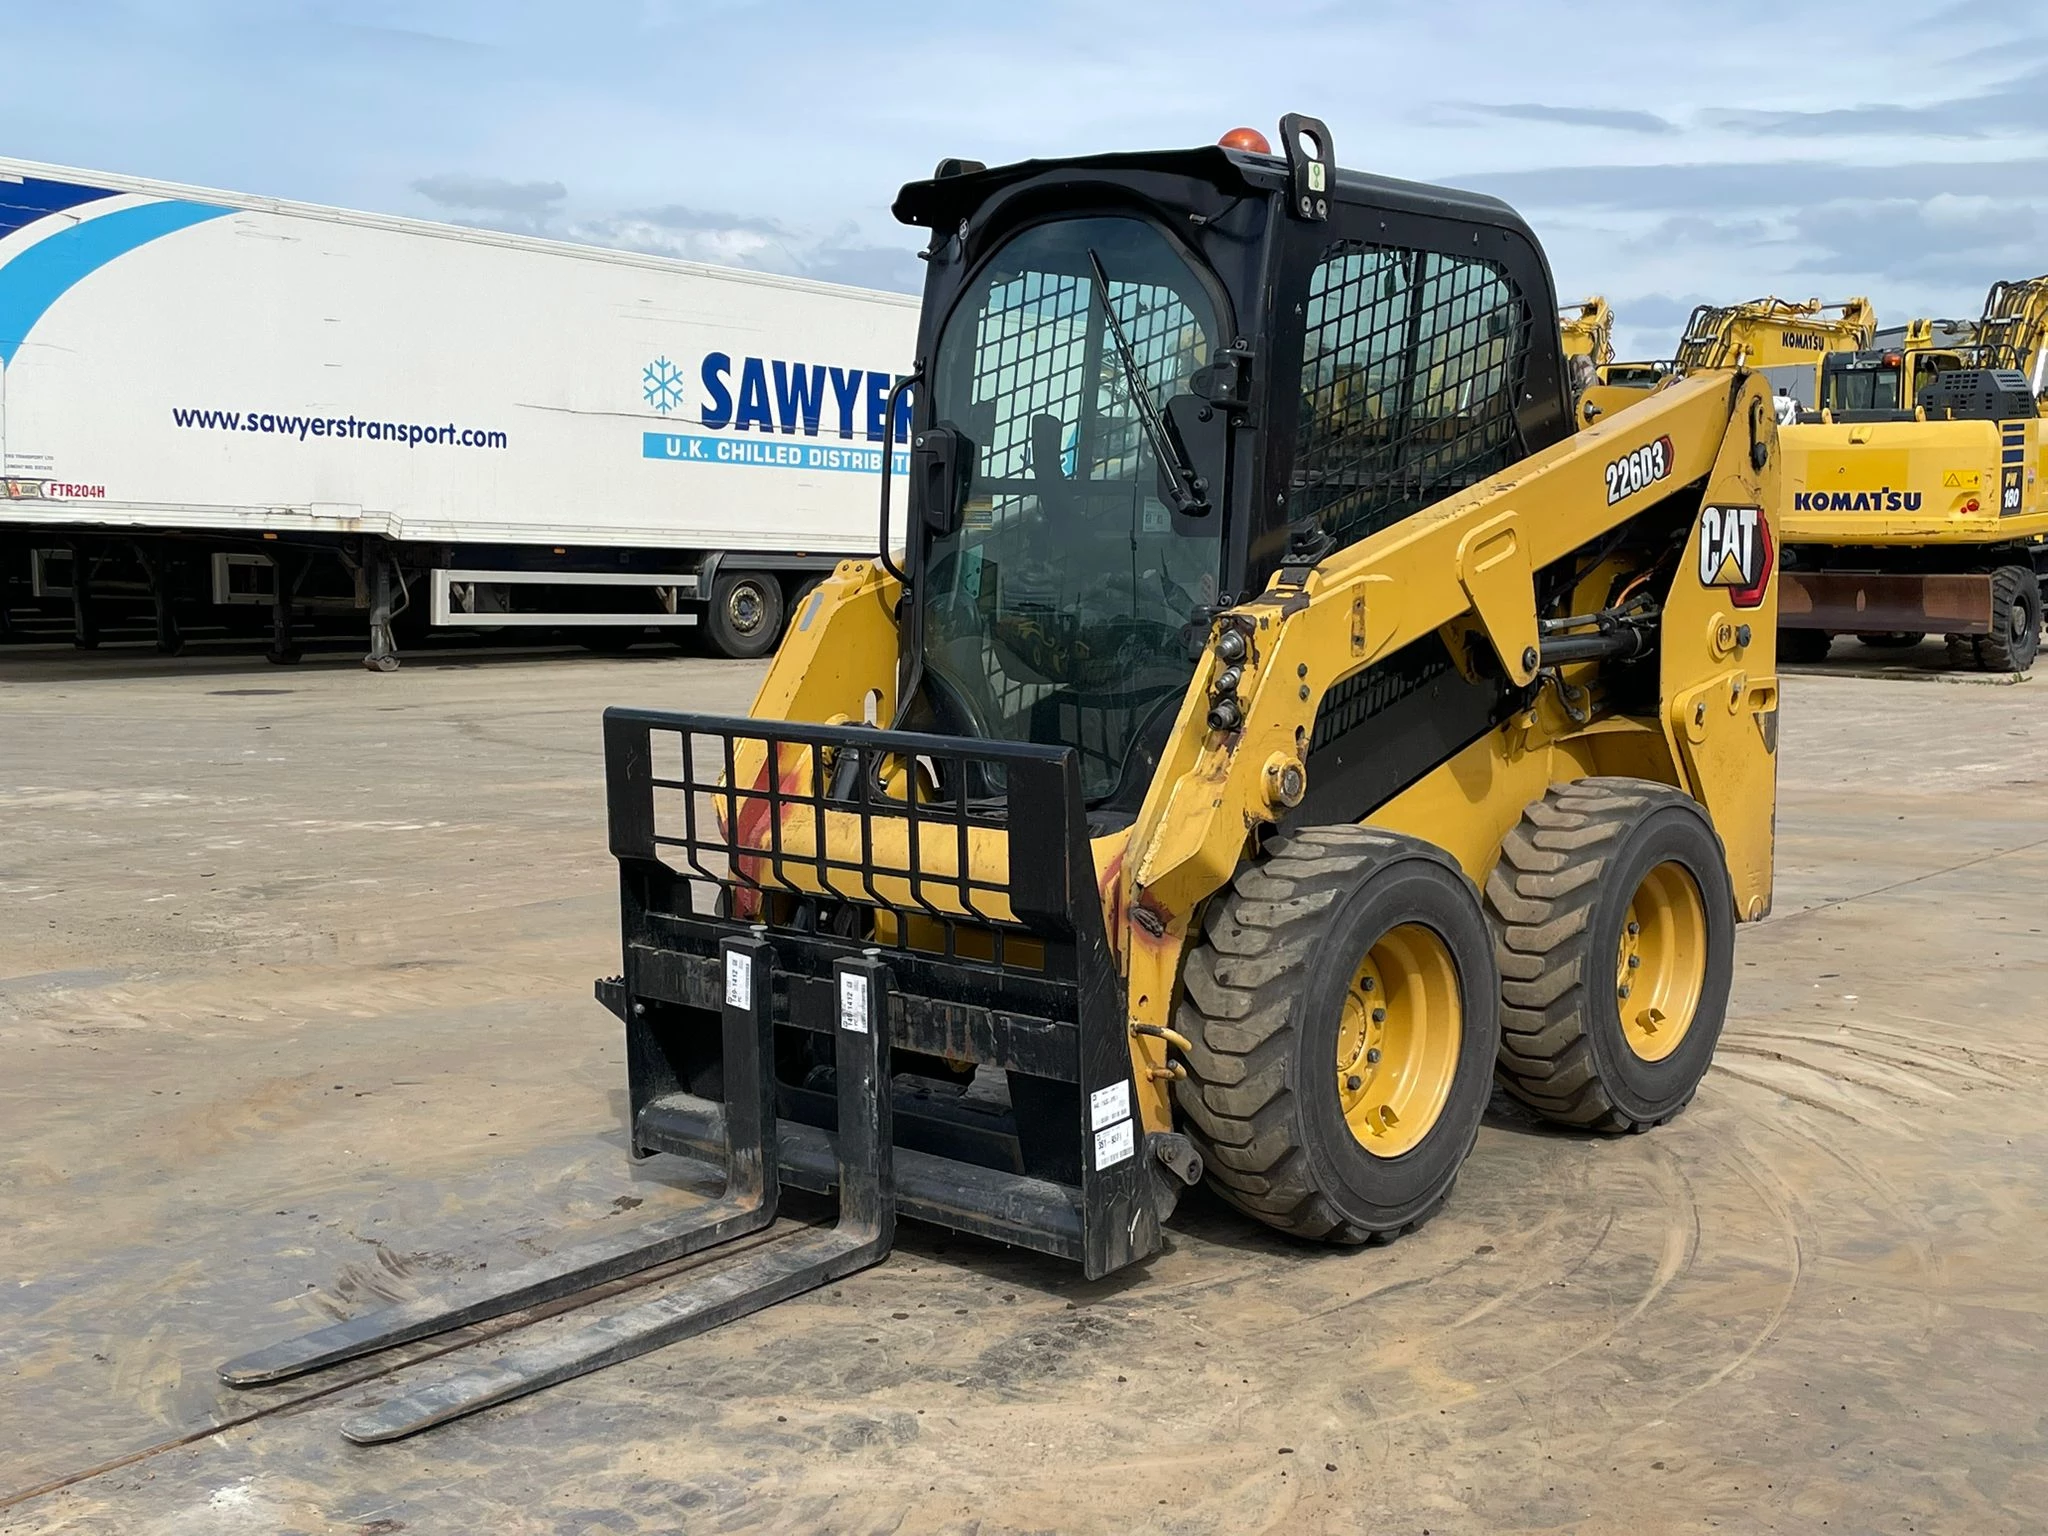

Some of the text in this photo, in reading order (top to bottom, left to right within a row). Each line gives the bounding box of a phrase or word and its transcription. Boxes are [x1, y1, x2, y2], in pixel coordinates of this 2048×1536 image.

[1782, 331, 1825, 351] KOMATSU
[172, 407, 507, 449] www.sawyerstransport.com
[666, 437, 911, 474] U.K. CHILLED DISTRIBTI
[1605, 440, 1666, 505] 226D3
[50, 482, 105, 498] FTR204H
[1794, 486, 1922, 511] KOMATSU
[2004, 488, 2020, 508] 180
[1701, 506, 1758, 585] CAT
